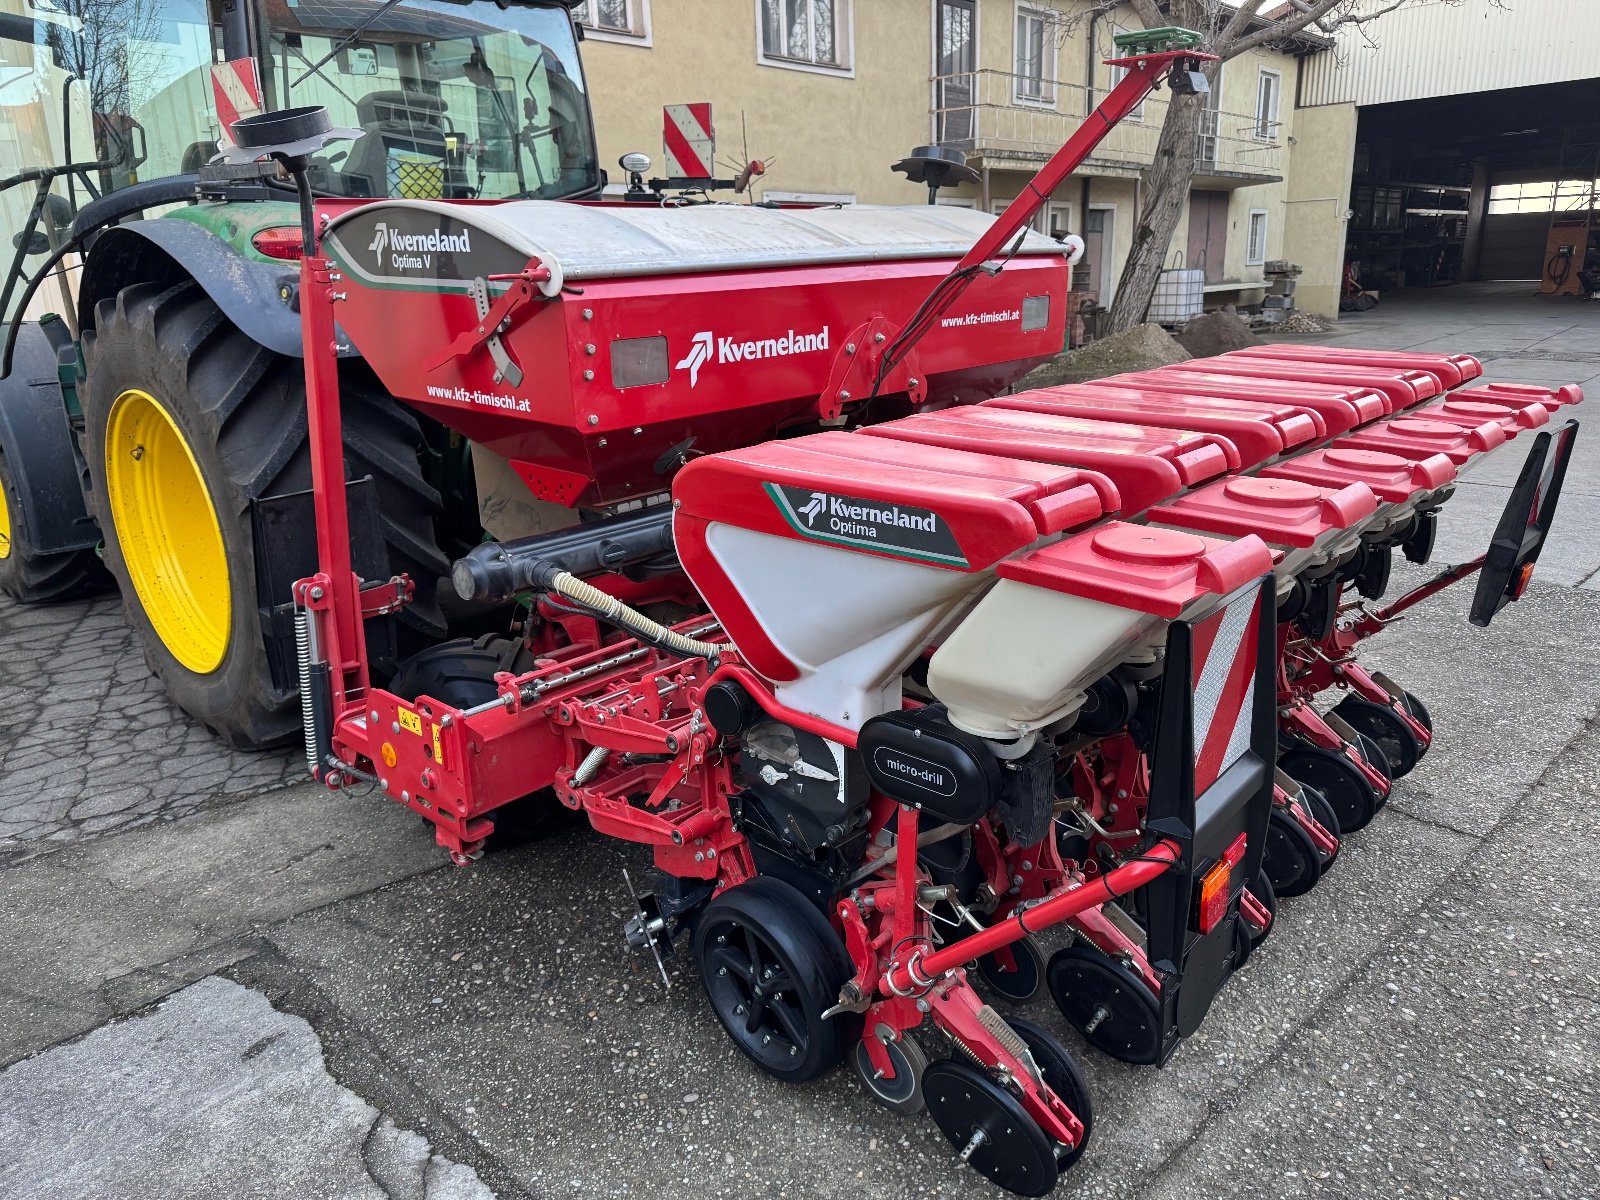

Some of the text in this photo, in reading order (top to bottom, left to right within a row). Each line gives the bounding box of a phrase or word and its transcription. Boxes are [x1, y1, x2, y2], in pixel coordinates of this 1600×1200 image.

[389, 228, 471, 252] Kverneland
[392, 254, 431, 271] Optima V
[941, 309, 1020, 328] www.kfz-timischl.at
[717, 325, 830, 364] Kverneland
[426, 385, 532, 412] www.kfz-timischl.at
[830, 496, 937, 533] Kverneland
[830, 517, 877, 538] Optima
[887, 759, 943, 786] micro-drill
